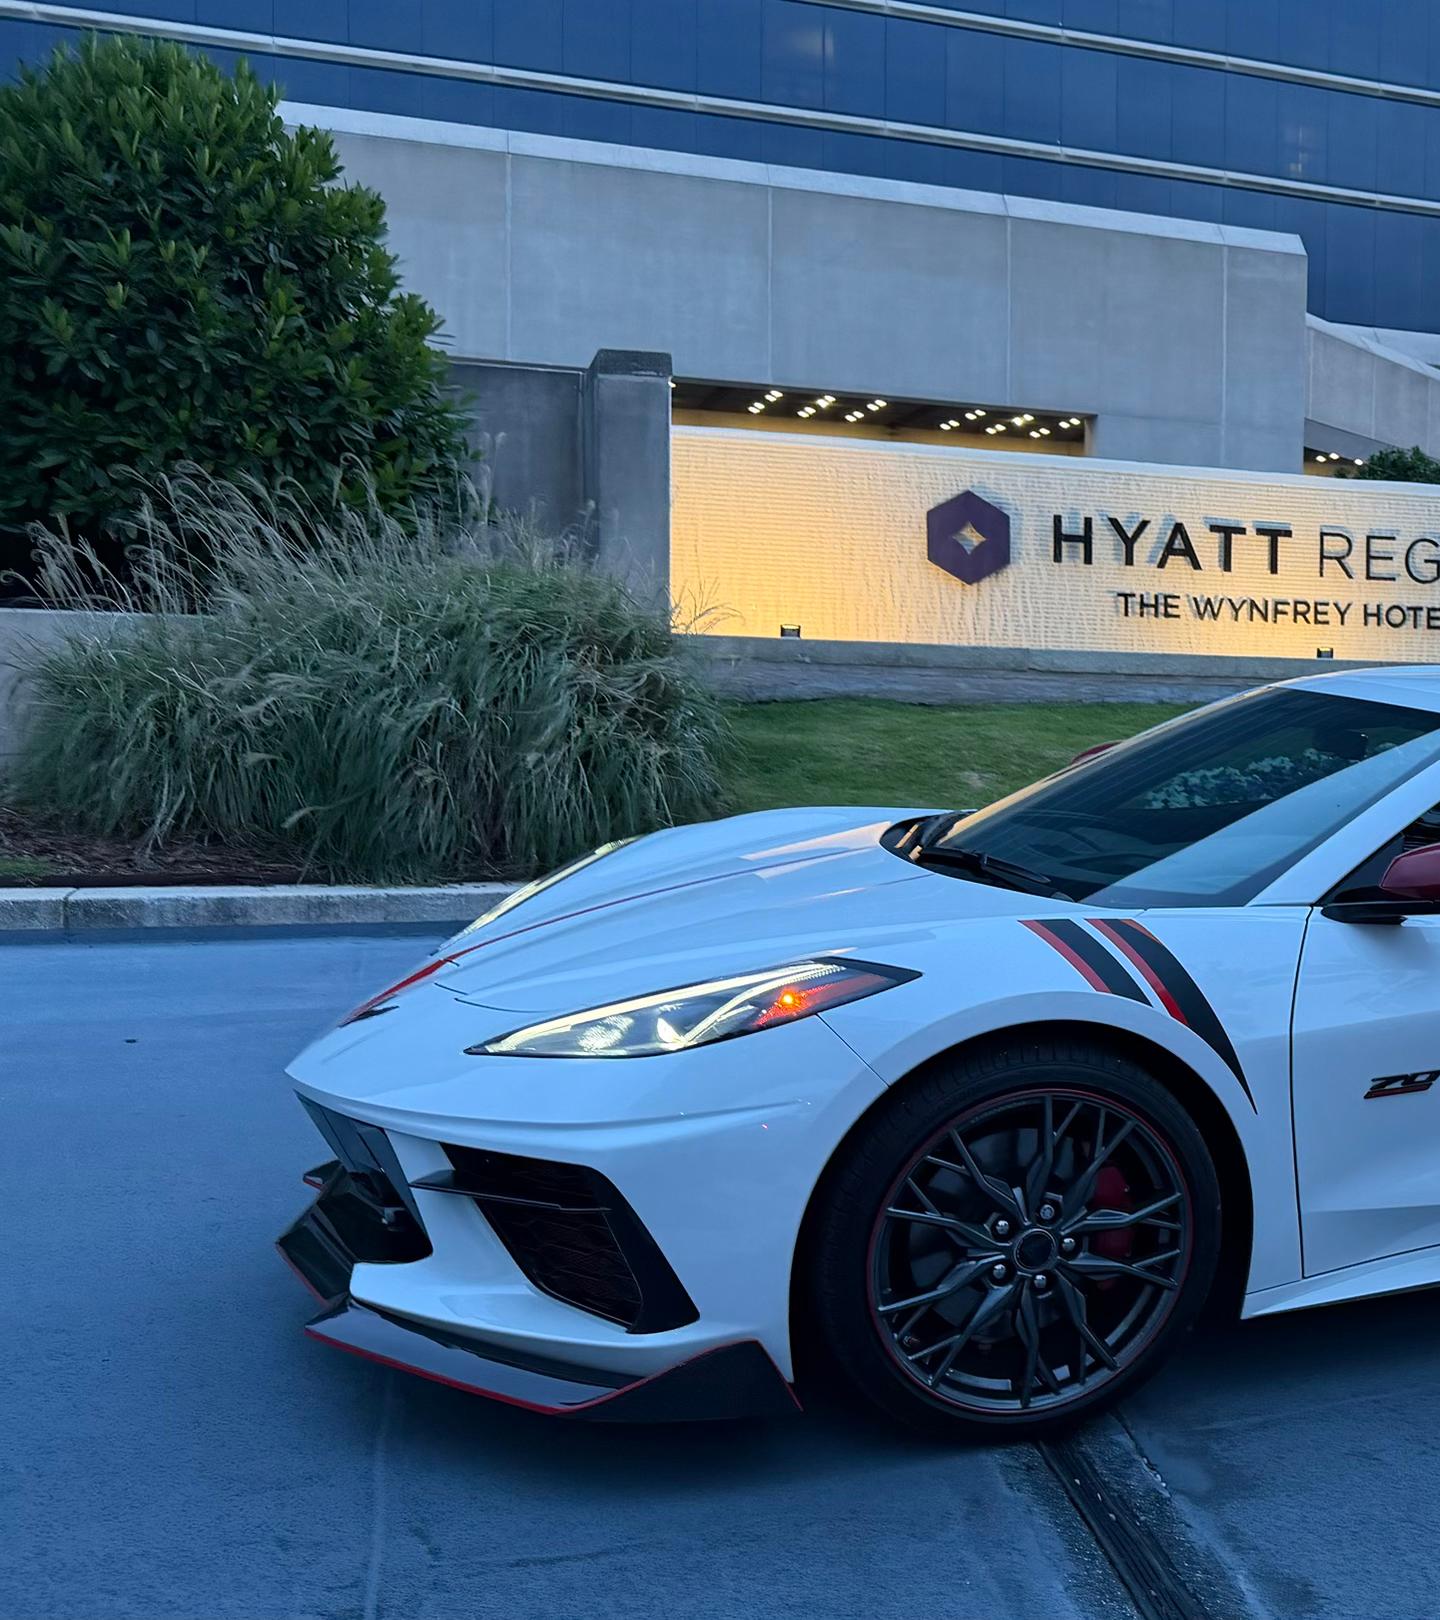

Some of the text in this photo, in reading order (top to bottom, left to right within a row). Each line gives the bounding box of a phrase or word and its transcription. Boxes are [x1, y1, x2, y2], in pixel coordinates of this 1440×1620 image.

[1053, 514, 1293, 575] HYATT
[1117, 592, 1181, 619] THE
[1192, 597, 1352, 626] WYNFREY
